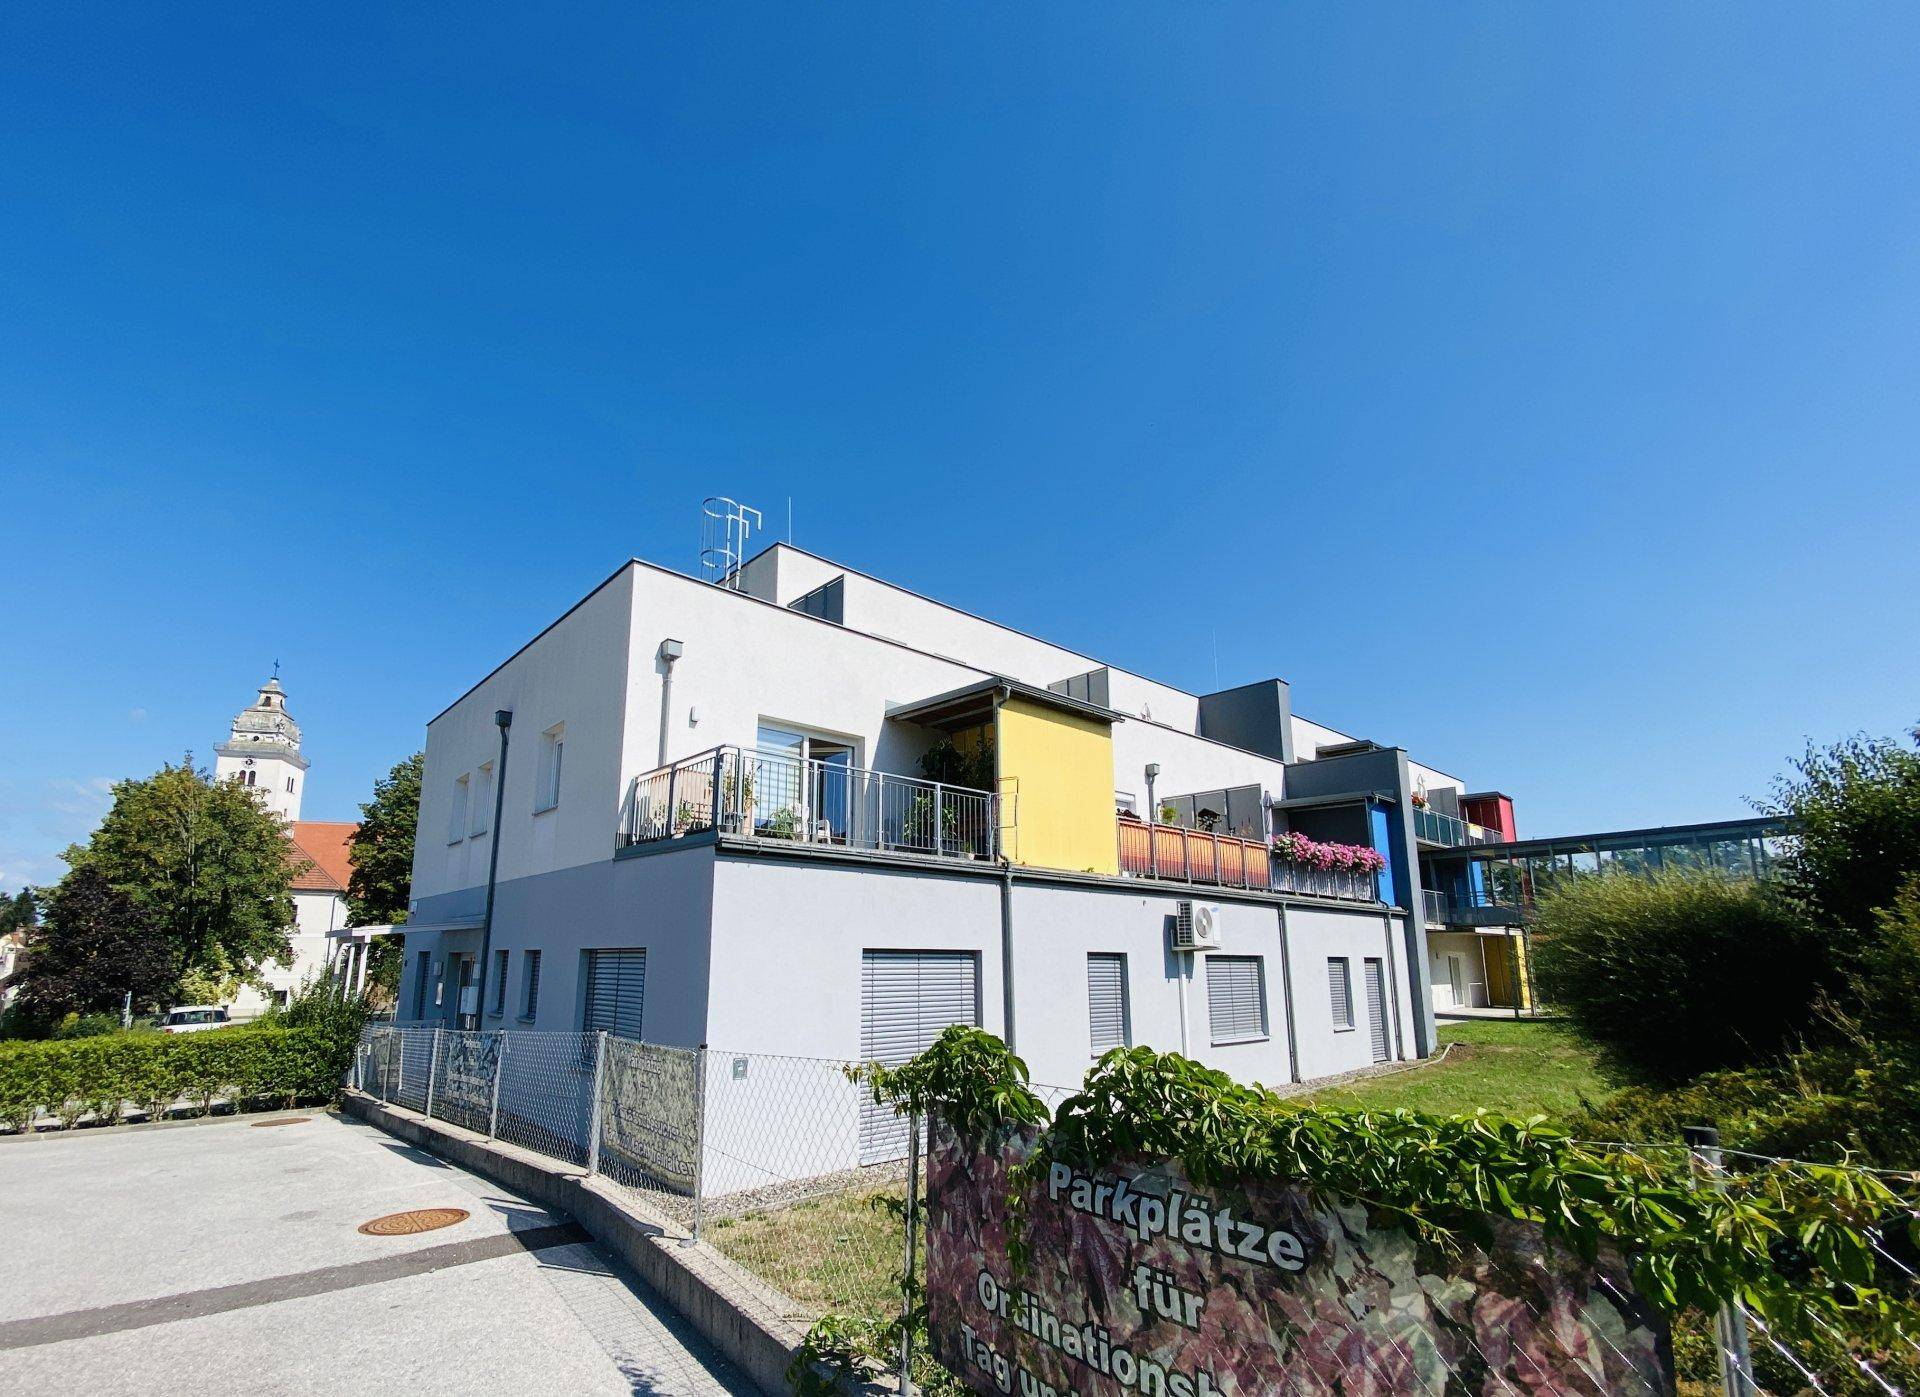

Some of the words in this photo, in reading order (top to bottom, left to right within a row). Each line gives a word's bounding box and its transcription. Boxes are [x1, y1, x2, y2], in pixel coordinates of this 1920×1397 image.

[1050, 1161, 1304, 1271] Parkplätze
[1133, 1265, 1203, 1329] für
[961, 1324, 1011, 1394] Tag
[1019, 1368, 1080, 1397] un
